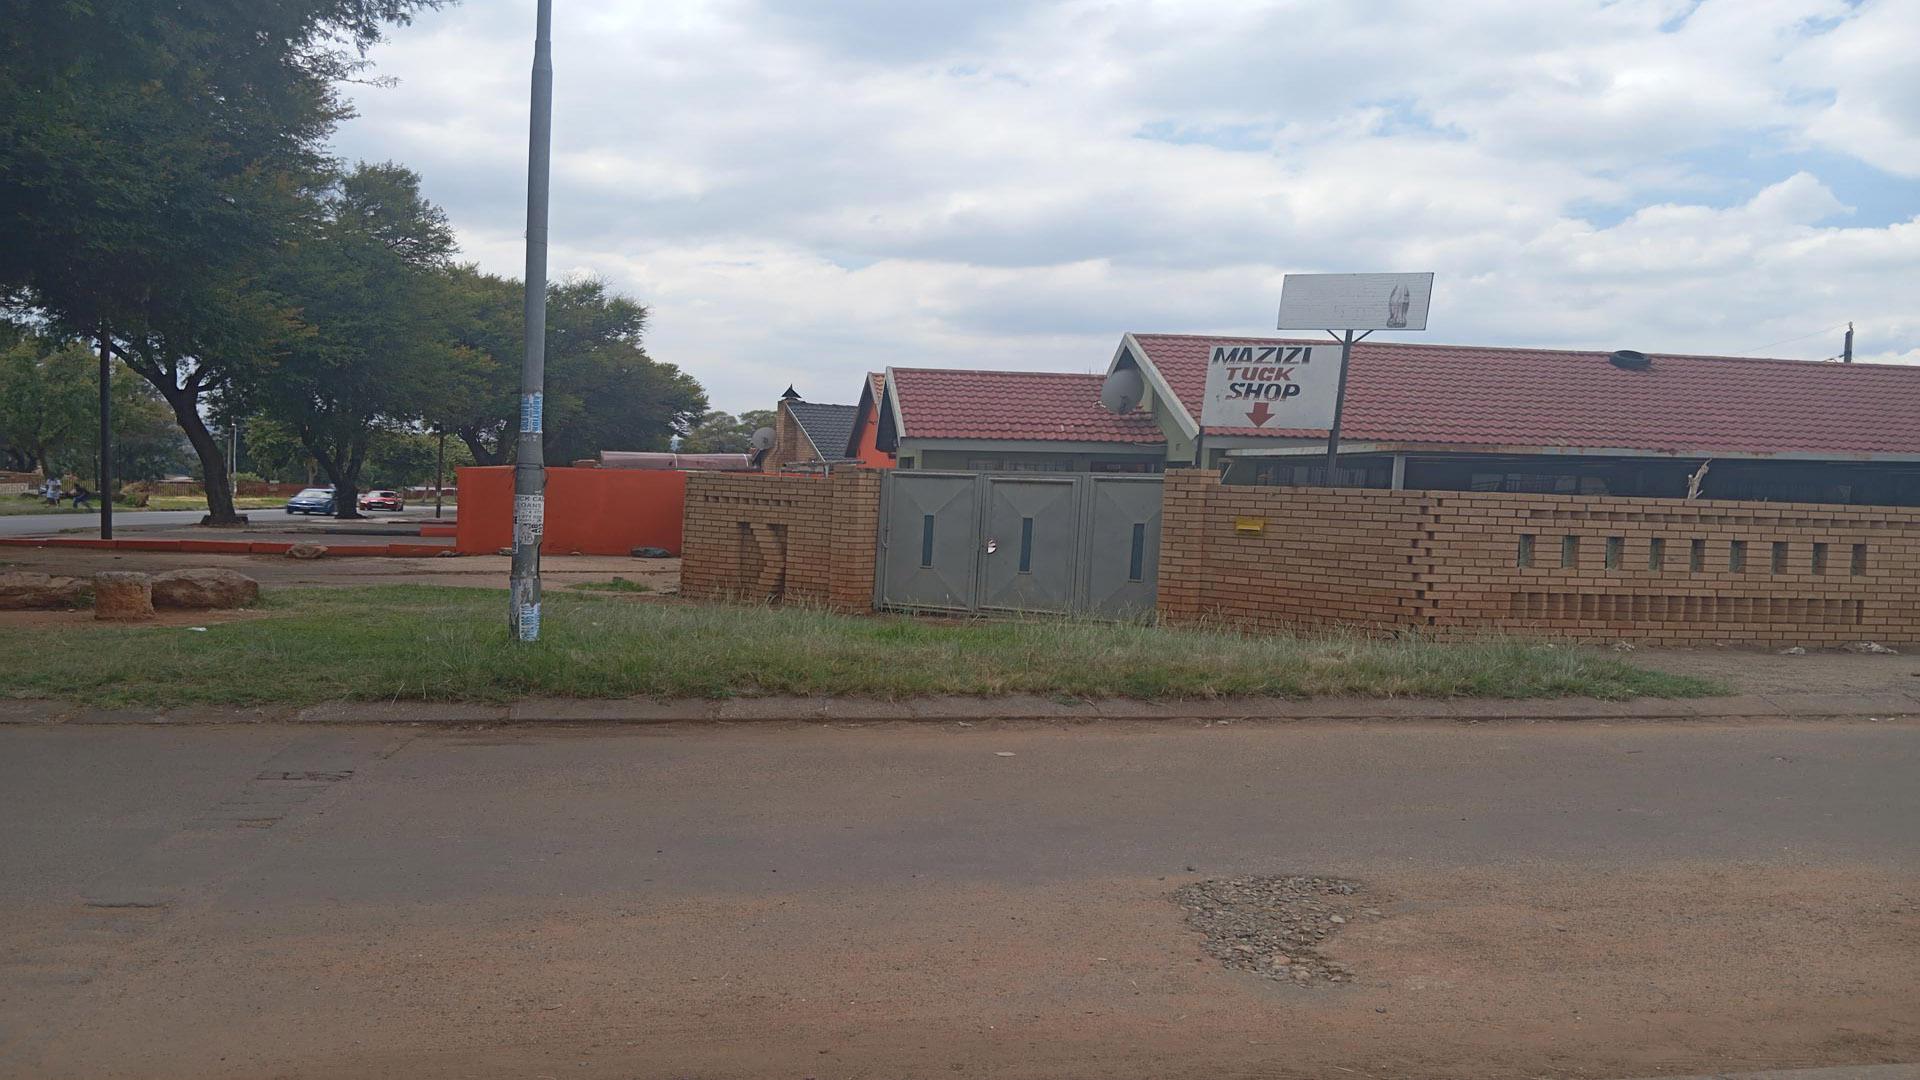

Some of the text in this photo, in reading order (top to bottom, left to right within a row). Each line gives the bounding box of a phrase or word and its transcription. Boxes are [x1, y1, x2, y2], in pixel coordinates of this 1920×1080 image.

[1212, 347, 1312, 365] MAZIZI
[1226, 367, 1295, 381] TUCK
[1225, 383, 1300, 401] SHOP
